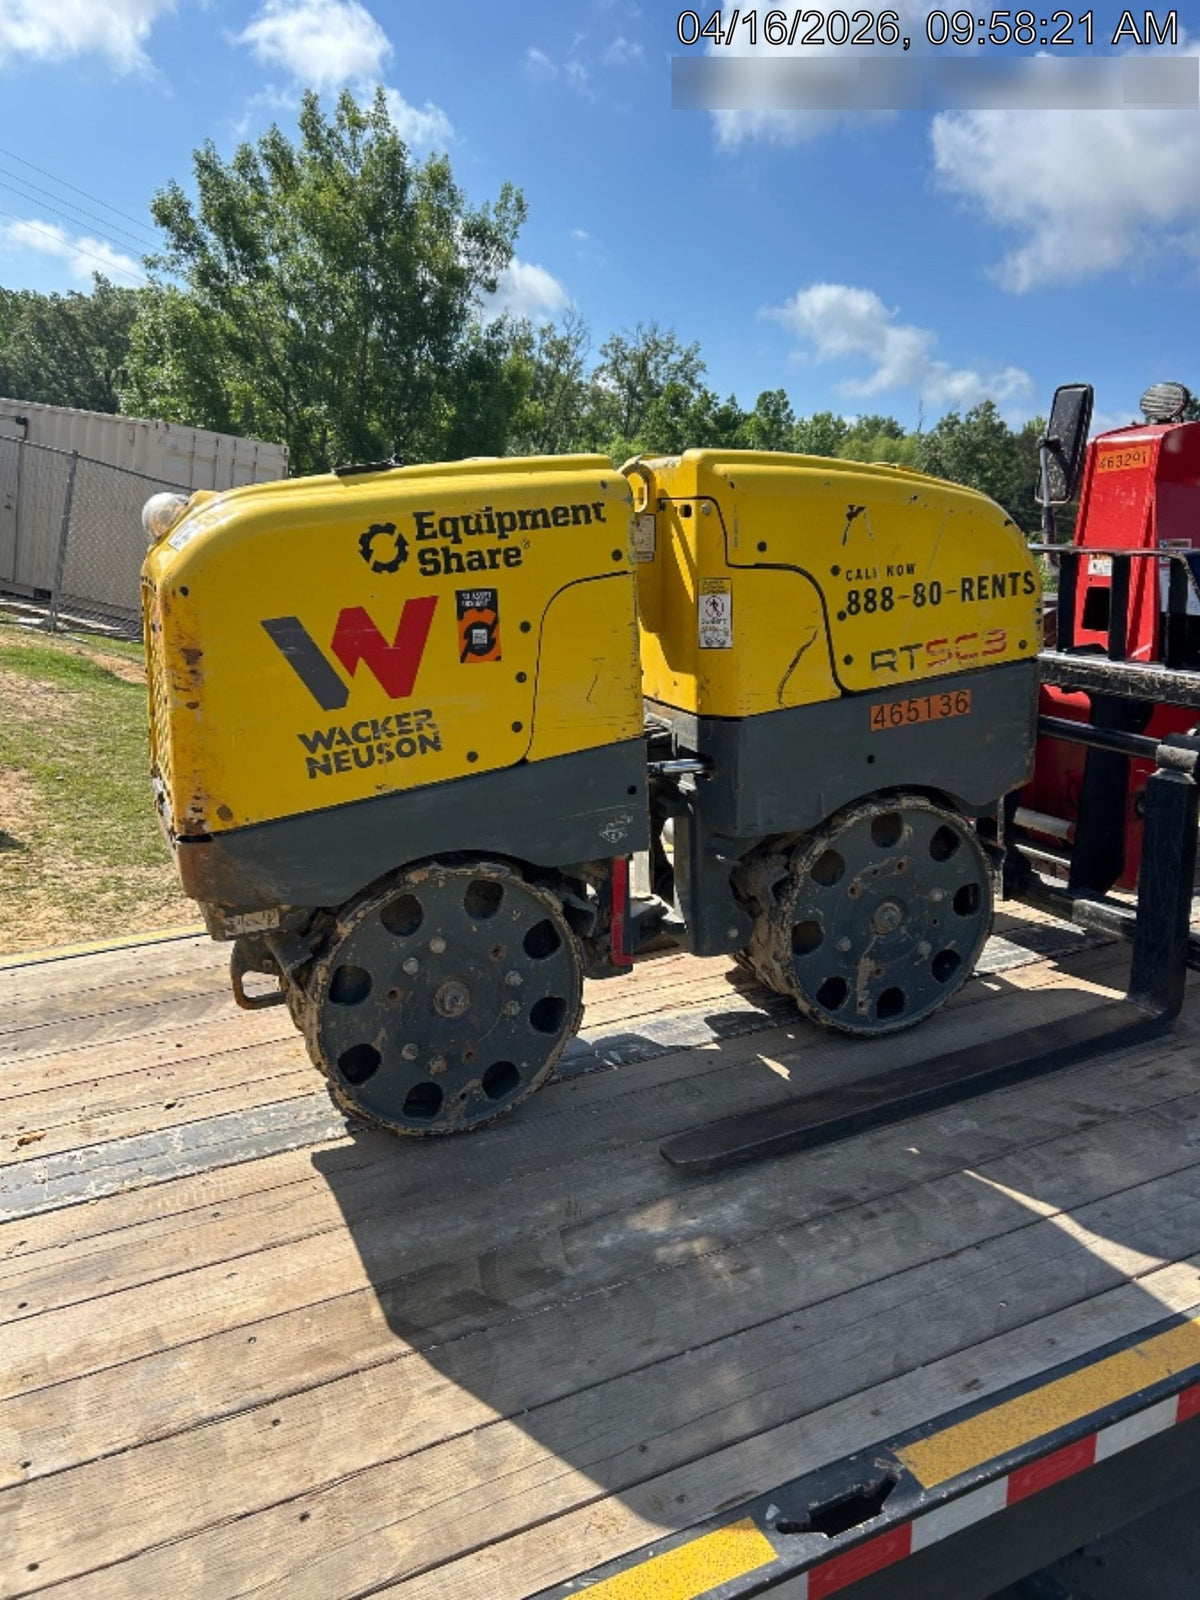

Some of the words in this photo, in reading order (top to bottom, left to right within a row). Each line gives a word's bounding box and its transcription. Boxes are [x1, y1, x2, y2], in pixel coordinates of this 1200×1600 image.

[412, 501, 608, 544] Equipment
[886, 563, 917, 578] NOW
[845, 570, 1036, 616] 888-80-RENTS
[297, 708, 439, 754] WACKER
[872, 690, 971, 729] 465136
[305, 730, 443, 779] NEUSON
